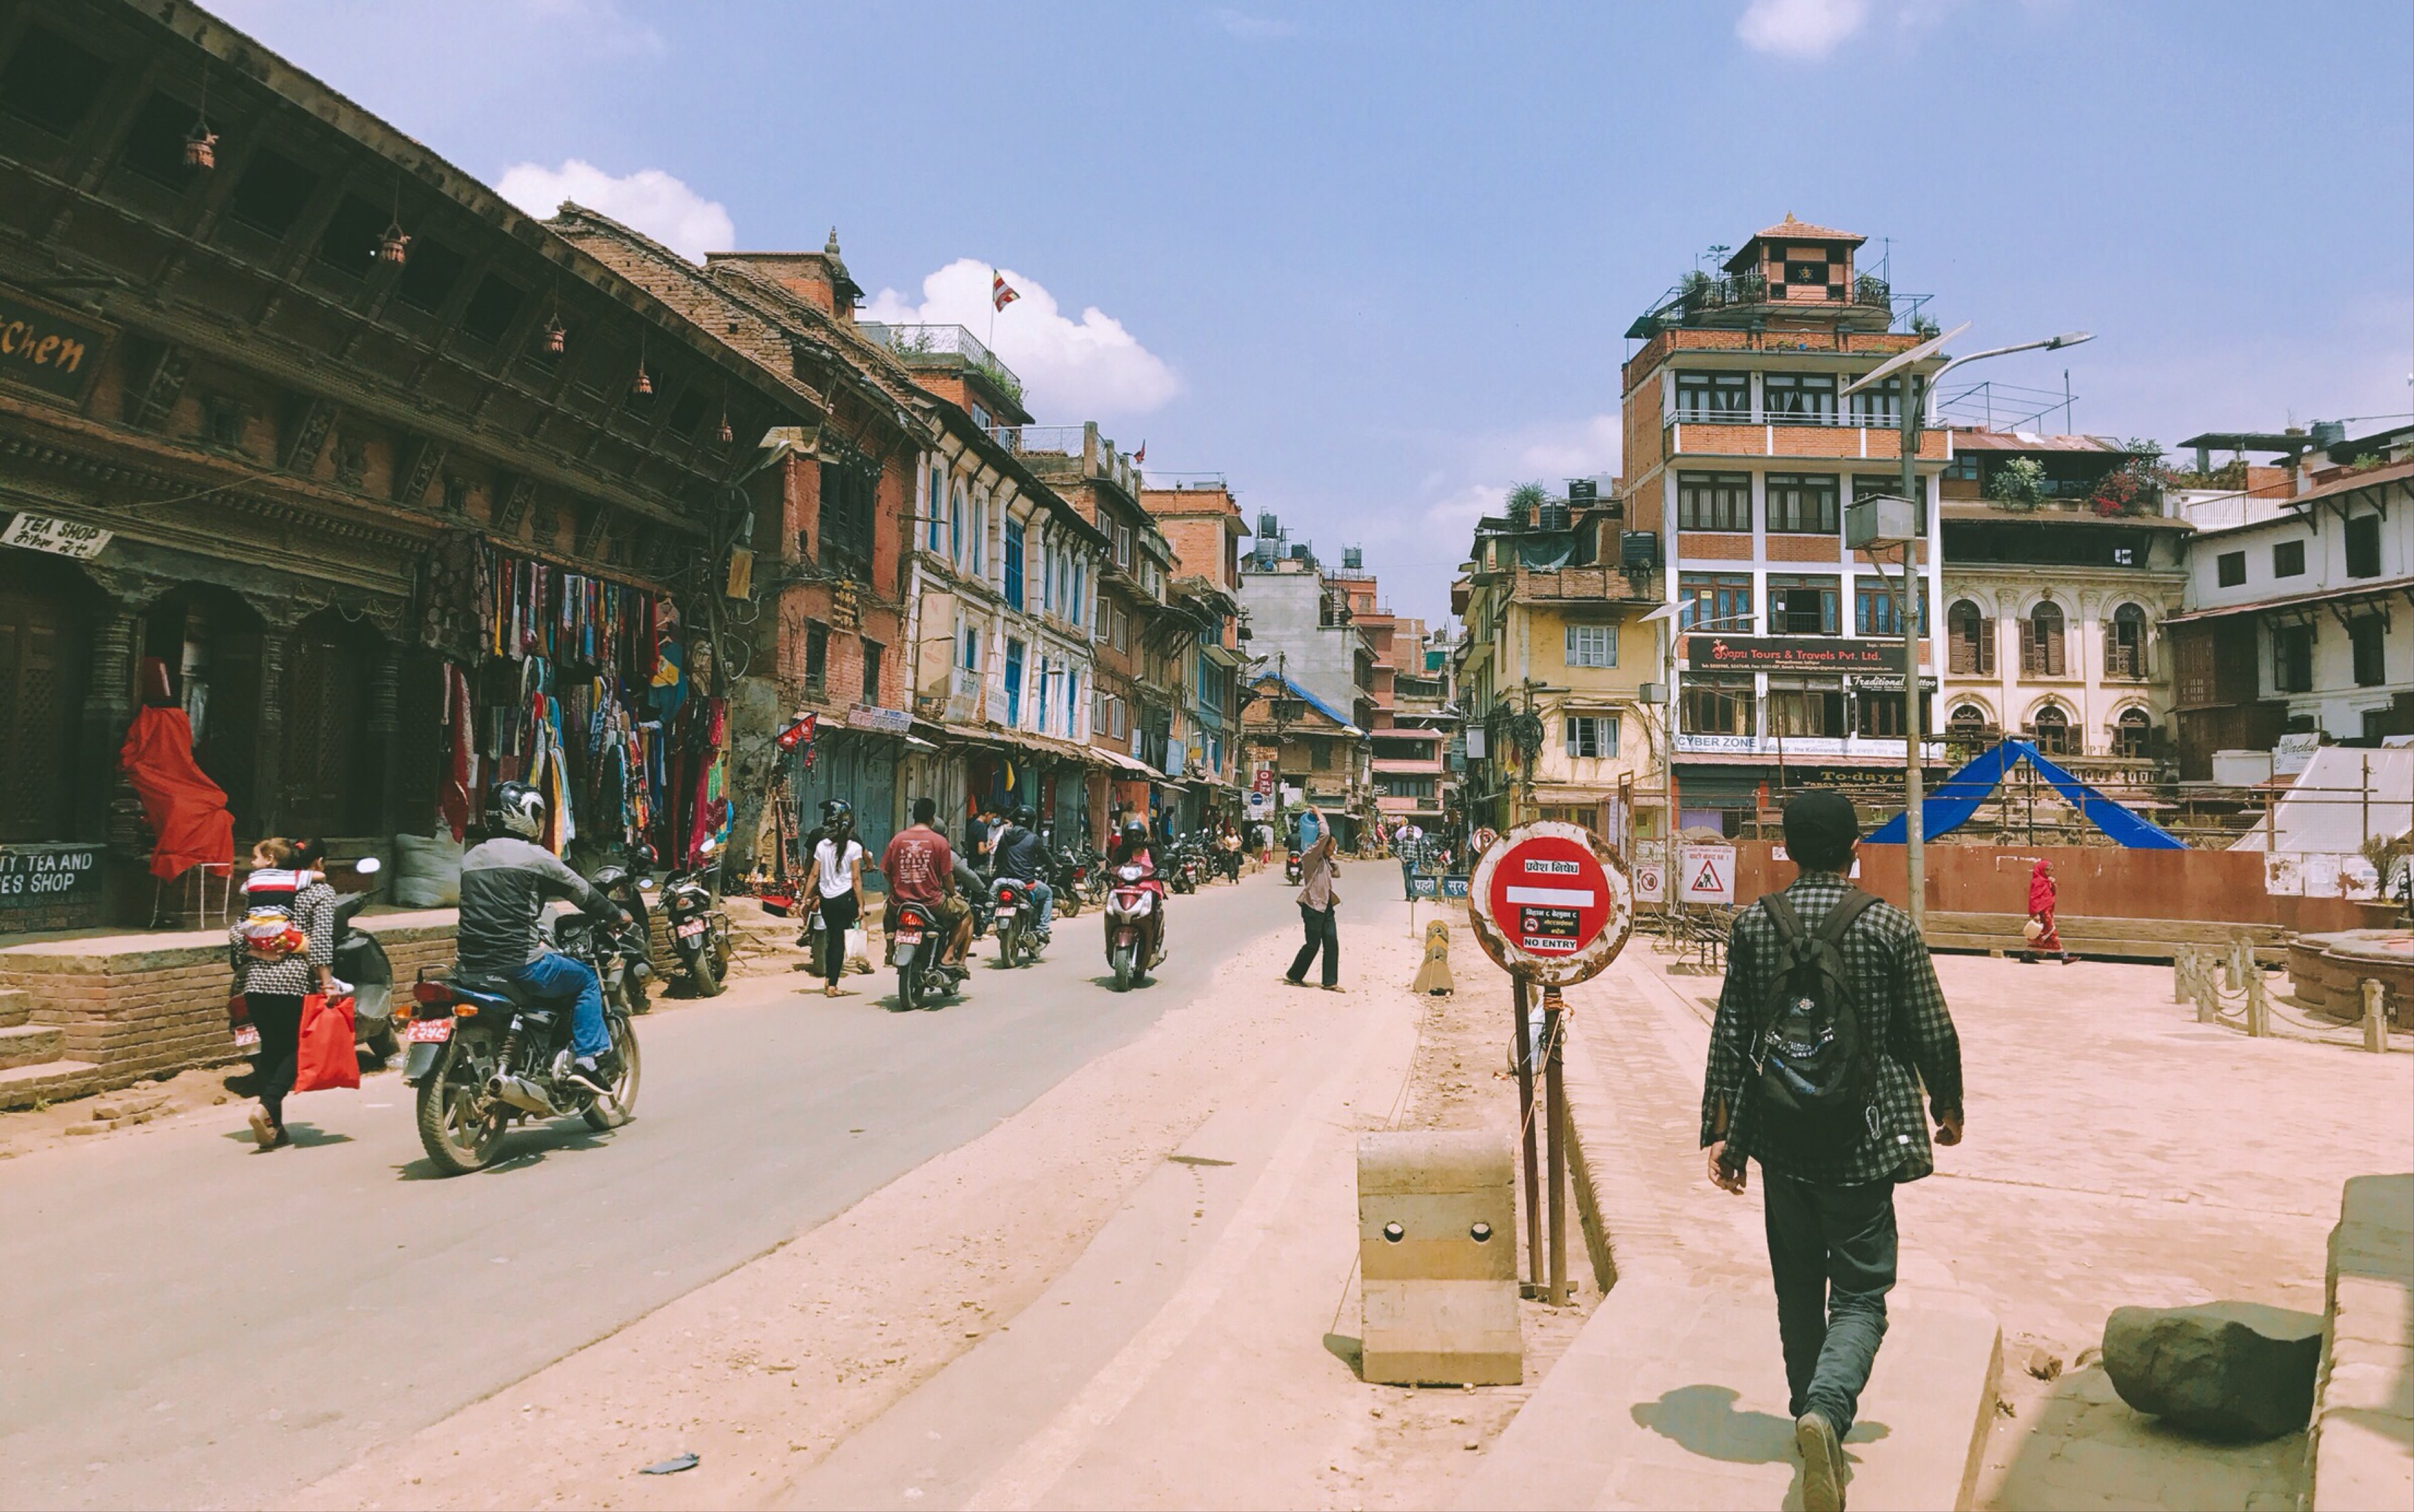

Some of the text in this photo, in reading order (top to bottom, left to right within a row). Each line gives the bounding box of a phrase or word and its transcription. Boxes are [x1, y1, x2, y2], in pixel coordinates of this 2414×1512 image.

[0, 315, 85, 373] chen
[20, 515, 100, 542] TEA SHOP
[1751, 650, 1781, 659] Tours
[1785, 650, 1793, 659] &
[1796, 650, 1835, 660] Travels
[1839, 650, 1858, 661] Pvt.
[1861, 650, 1882, 661] Ltd.
[1853, 675, 1906, 687] Traditional
[1677, 736, 1757, 748] CYBER ZONE
[27, 855, 57, 872] TEA
[59, 853, 93, 870] AND
[1526, 861, 1578, 873] प्रवेश निषेध
[0, 873, 75, 894] ES SHOP
[1524, 938, 1576, 948] NO ENTRY
